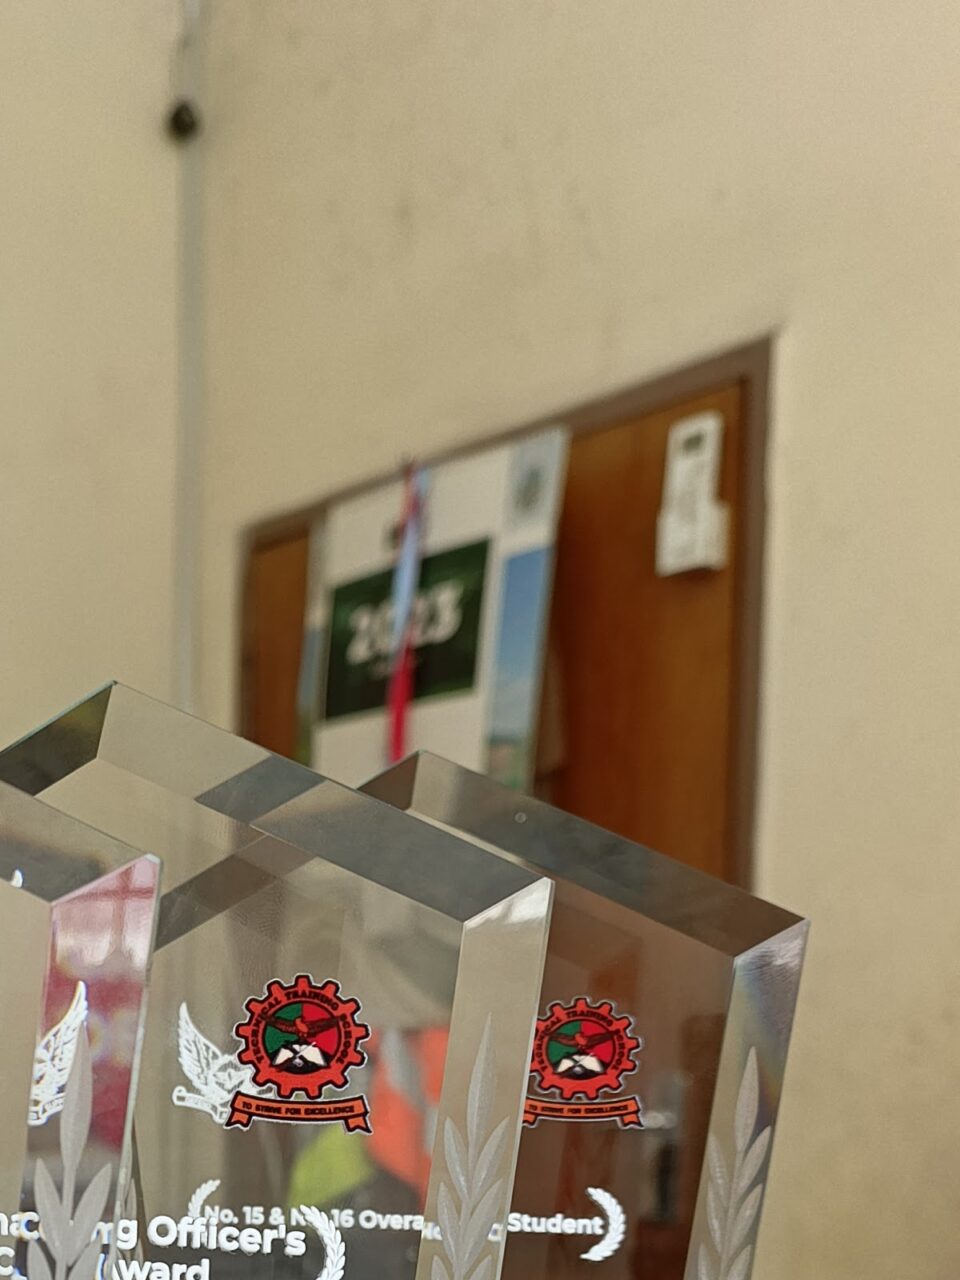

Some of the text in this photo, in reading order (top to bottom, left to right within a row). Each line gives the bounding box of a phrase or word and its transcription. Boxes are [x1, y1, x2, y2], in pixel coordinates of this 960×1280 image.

[147, 1215, 307, 1256] Officer's
[204, 1205, 239, 1224] No.
[242, 1206, 265, 1225] 15
[268, 1206, 286, 1225] &
[330, 1208, 355, 1229] 16
[507, 1212, 606, 1237] Student
